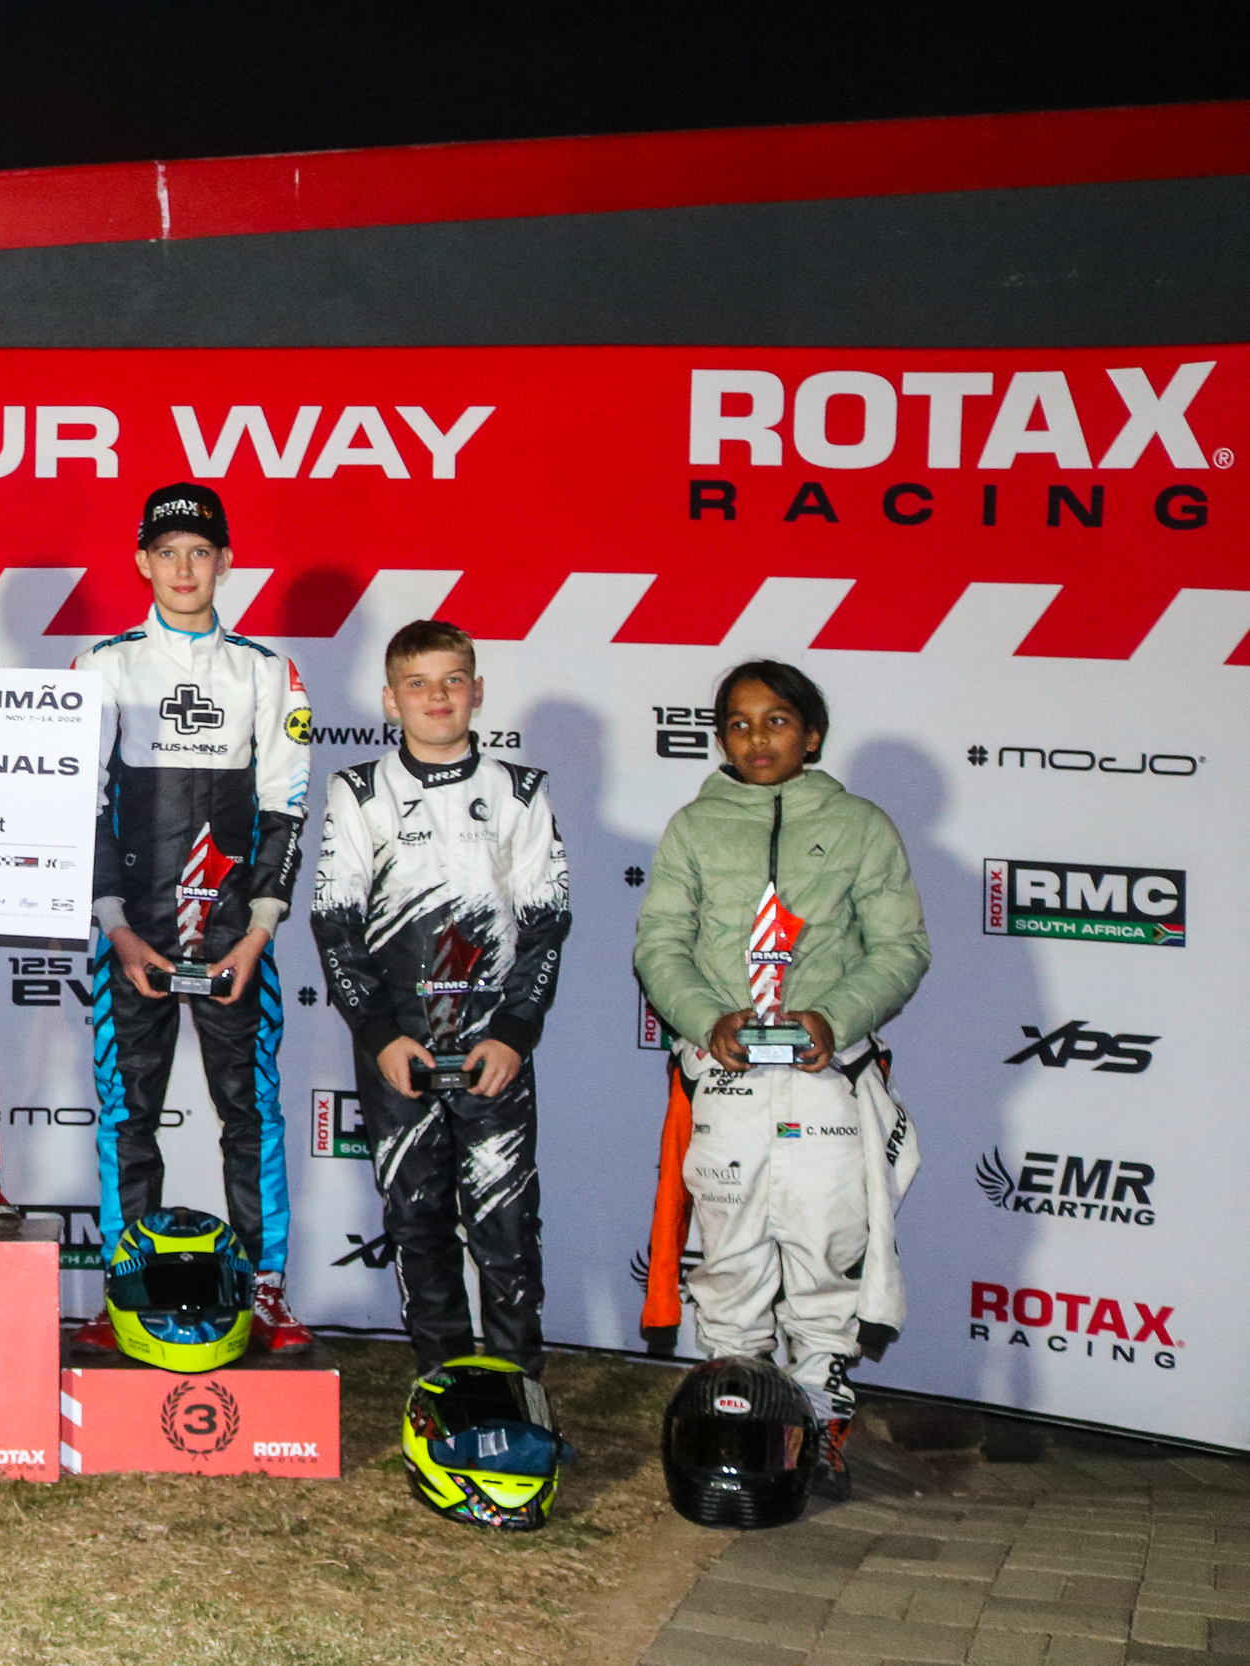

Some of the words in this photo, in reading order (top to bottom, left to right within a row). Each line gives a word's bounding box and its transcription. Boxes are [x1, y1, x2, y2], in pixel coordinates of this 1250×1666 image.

[171, 405, 497, 480] WAY
[689, 479, 1209, 531] RACING
[5, 714, 26, 722] NOV
[427, 768, 463, 783] HRX
[398, 830, 433, 842] LSM
[183, 887, 220, 897] RMC
[990, 869, 1003, 927] ROTAX
[1015, 868, 1178, 917] RMC
[1015, 919, 1077, 934] SOUTH
[1081, 923, 1146, 939] AFRICA
[752, 951, 791, 960] RMC
[8, 957, 73, 975] 125
[433, 981, 469, 990] RMC
[1003, 1019, 1163, 1074] XPS
[703, 1086, 754, 1096] AFRICA
[716, 1079, 736, 1087] OF
[317, 1099, 330, 1151] ROTAX
[1017, 1151, 1156, 1206] EMR
[1013, 1195, 1156, 1227] KARTING
[969, 1322, 1177, 1370] RACING
[719, 1400, 746, 1410] BELL
[183, 1403, 218, 1436] 3
[253, 1442, 318, 1457] ROTAX
